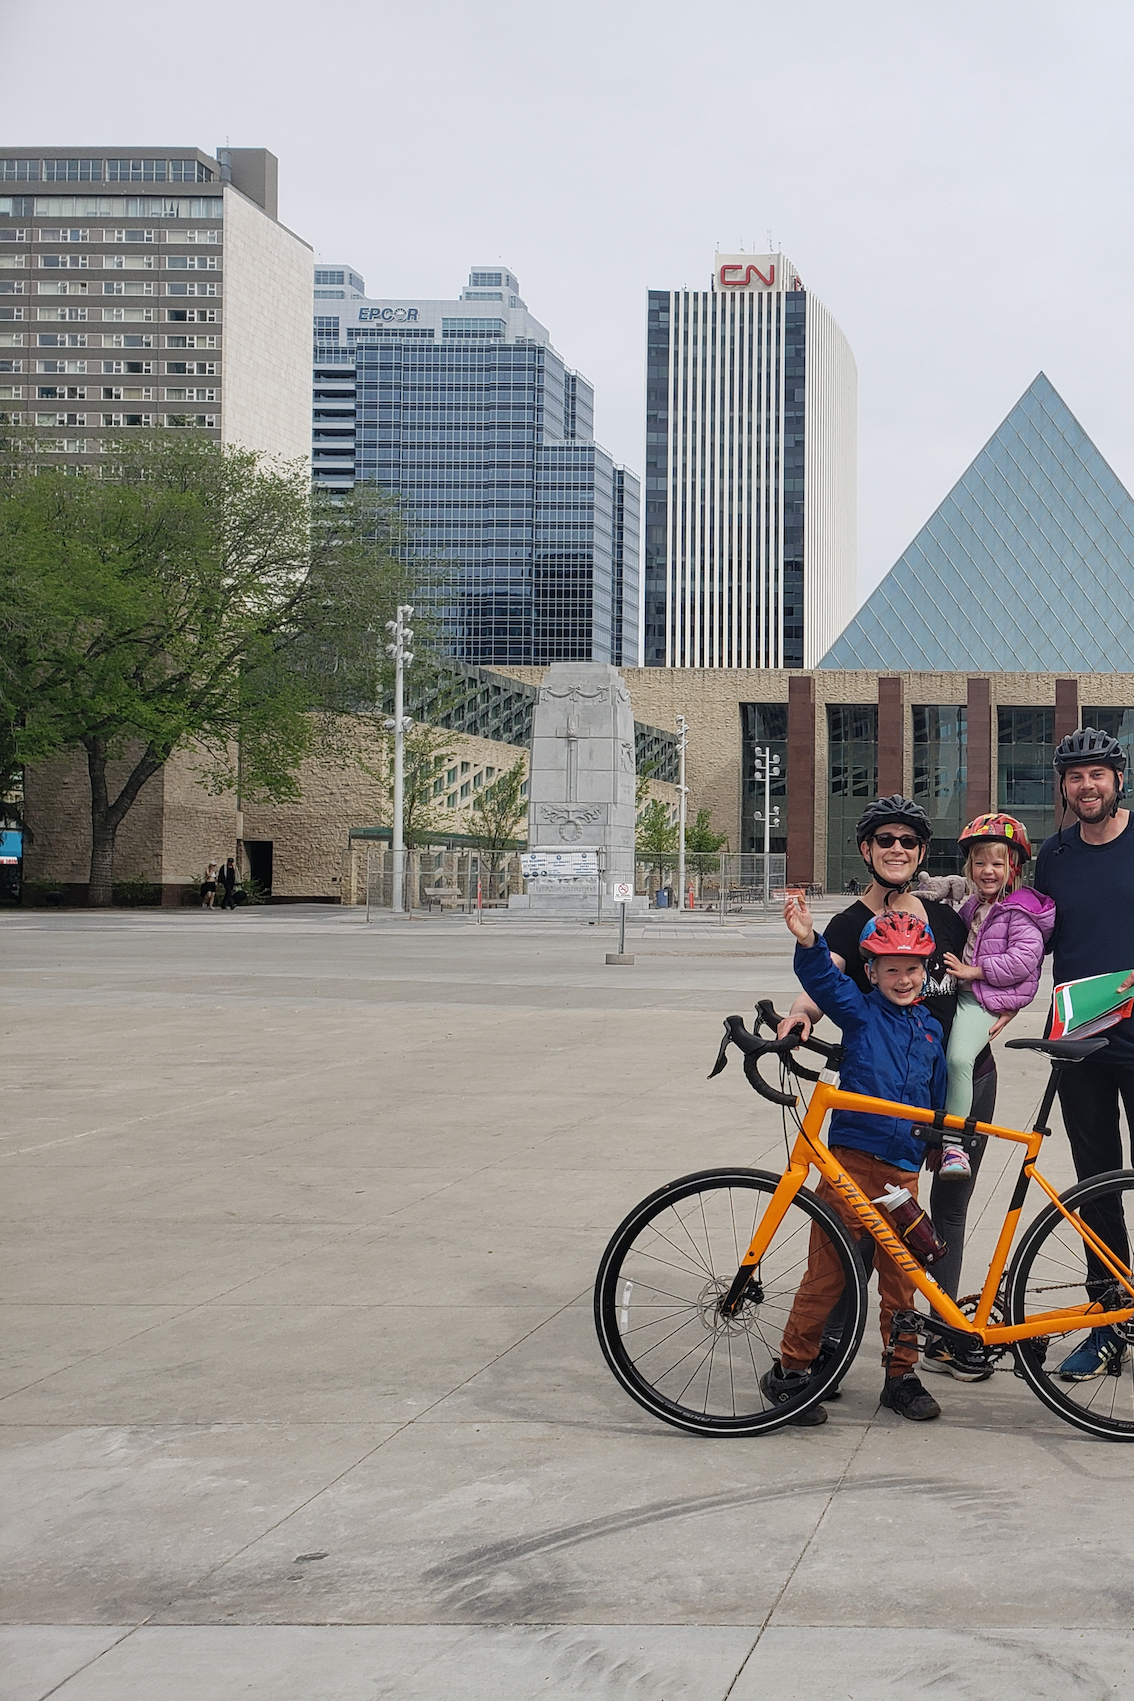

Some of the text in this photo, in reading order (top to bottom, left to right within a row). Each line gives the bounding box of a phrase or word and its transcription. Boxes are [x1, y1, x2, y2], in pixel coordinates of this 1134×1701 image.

[720, 264, 775, 286] CN
[358, 307, 419, 321] EPCOR
[828, 1172, 920, 1272] SPECIALIZED
